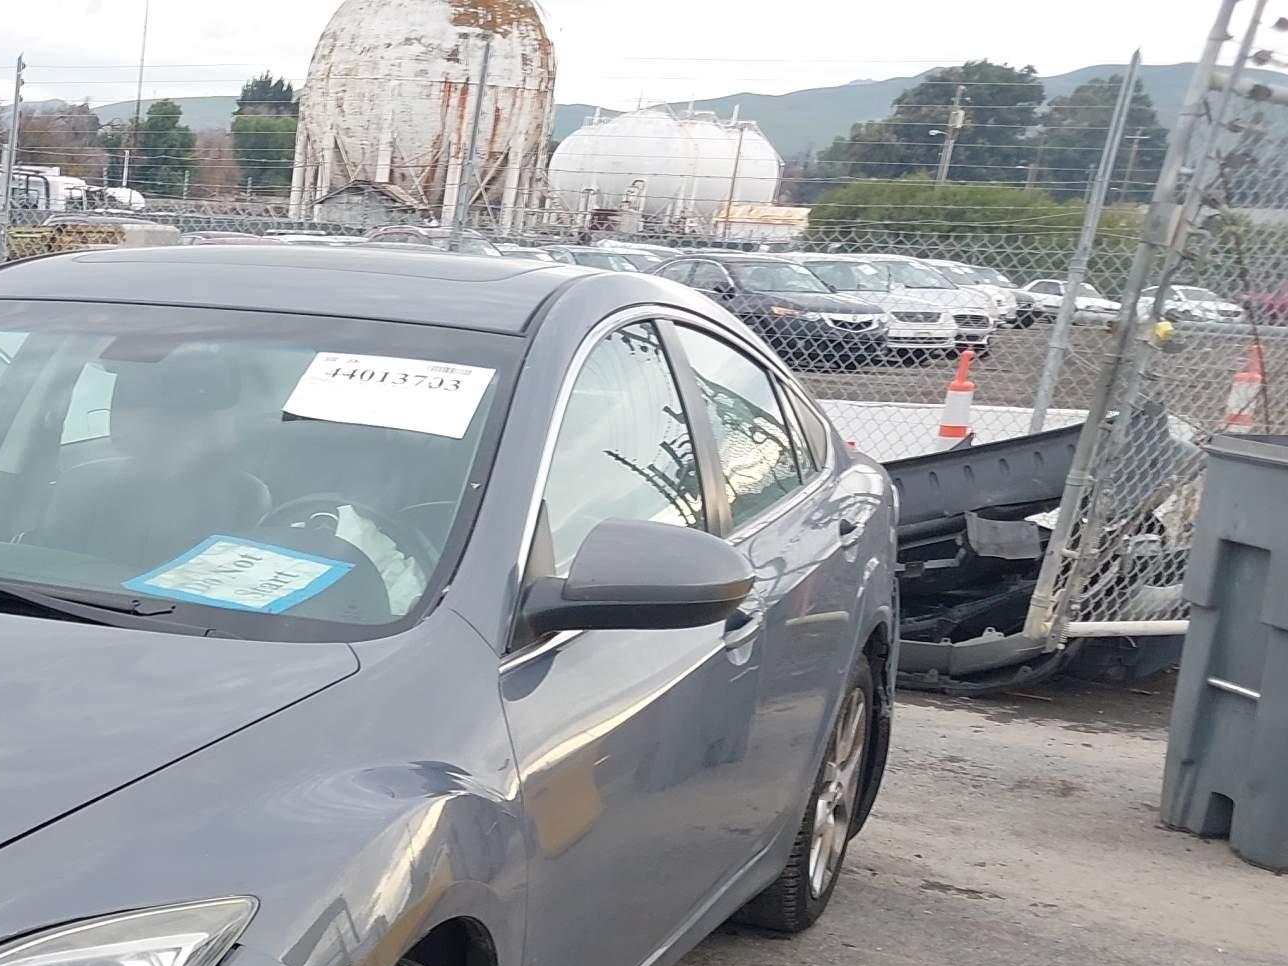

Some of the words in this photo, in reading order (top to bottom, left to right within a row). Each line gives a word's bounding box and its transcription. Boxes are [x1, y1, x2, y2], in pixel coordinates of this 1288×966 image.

[324, 367, 462, 392] 44013703
[215, 552, 264, 576] Not
[232, 570, 300, 600] Start
